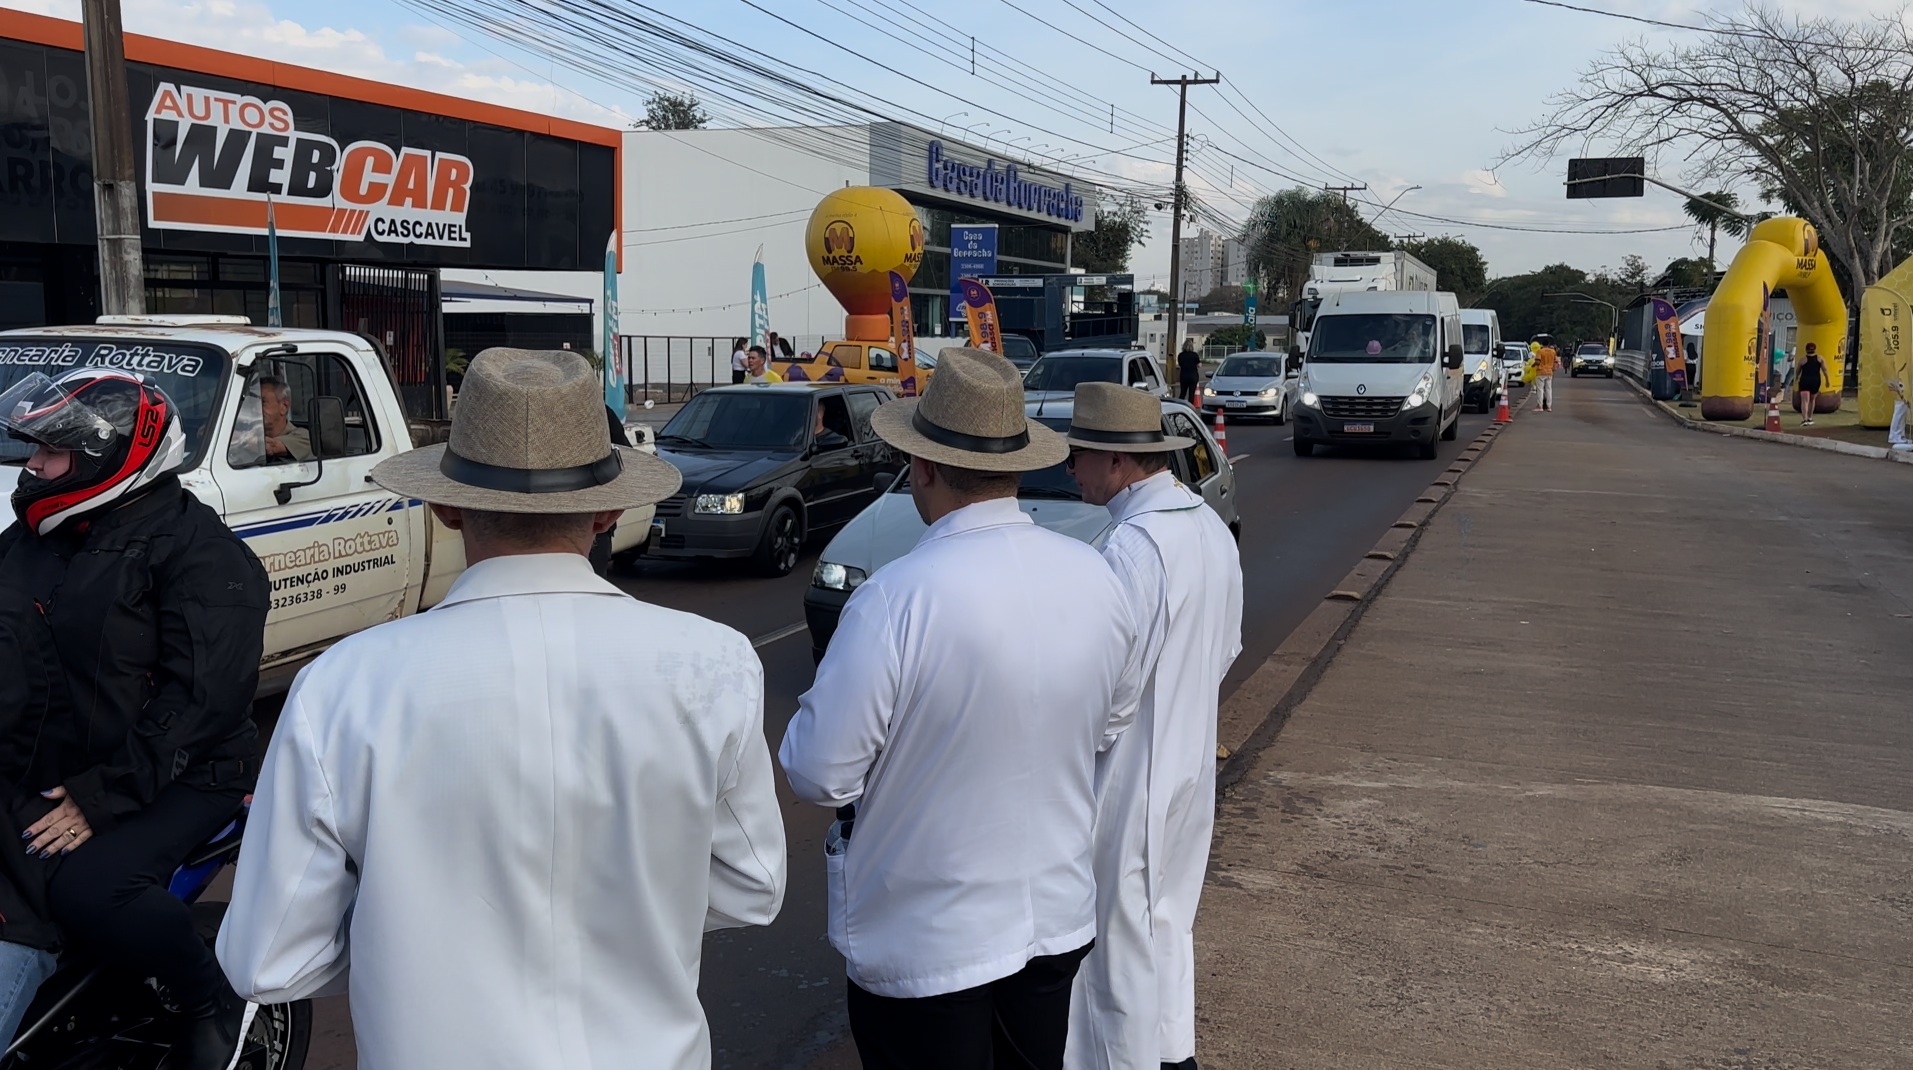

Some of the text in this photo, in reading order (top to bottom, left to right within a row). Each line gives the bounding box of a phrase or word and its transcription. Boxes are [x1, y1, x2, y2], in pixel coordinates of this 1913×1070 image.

[153, 89, 291, 133] AUTOS
[151, 117, 471, 213] WEBCAR
[928, 139, 1084, 223] Casa da Borracha
[373, 216, 468, 242] CASCAVEL
[963, 230, 983, 240] Casa
[953, 248, 992, 258] Borracha
[967, 240, 978, 250] da
[822, 255, 864, 266] MASSA
[977, 311, 989, 339] 98.9
[1664, 323, 1673, 344] 98.9
[1891, 325, 1900, 350] 105.9
[0, 343, 203, 377] nearia Rottava
[138, 408, 159, 448] LS2
[332, 529, 400, 560] Rottava
[332, 553, 396, 579] INDUSTRIAL
[333, 583, 347, 596] 99
